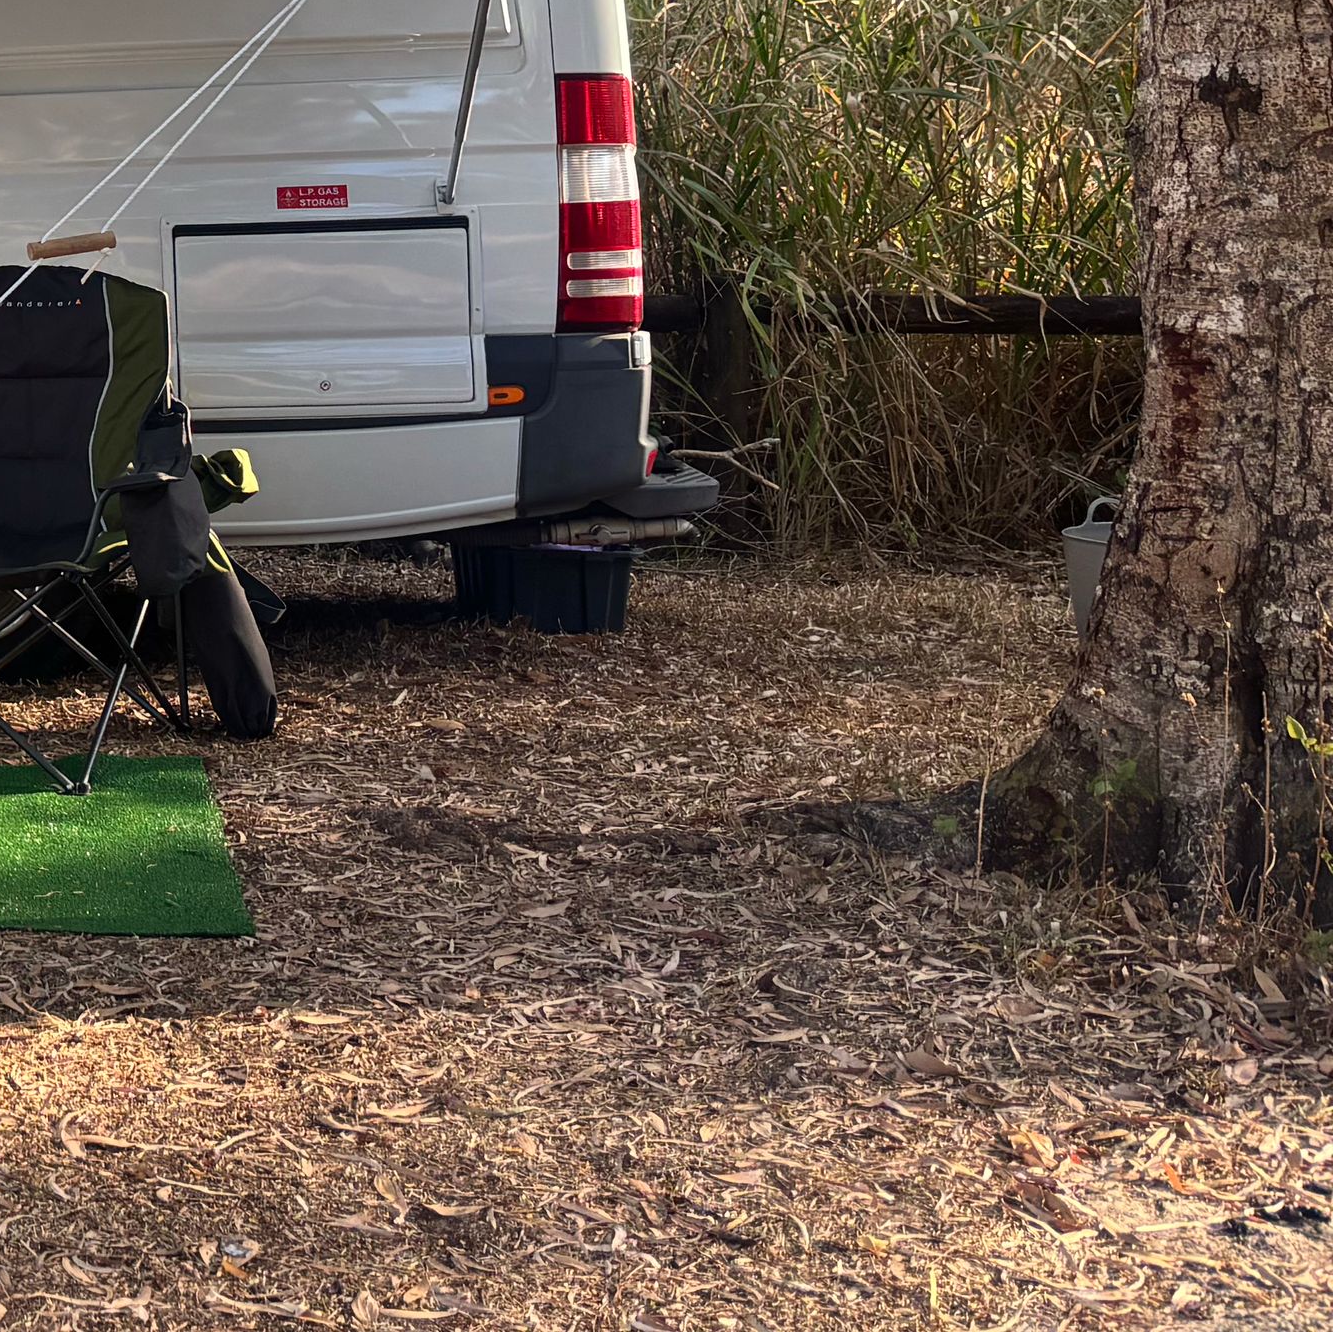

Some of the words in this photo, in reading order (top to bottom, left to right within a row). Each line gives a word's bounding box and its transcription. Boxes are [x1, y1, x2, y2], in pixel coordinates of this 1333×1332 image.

[299, 187, 315, 196] L.P.
[317, 187, 339, 196] GAS
[299, 197, 347, 207] STORAGE
